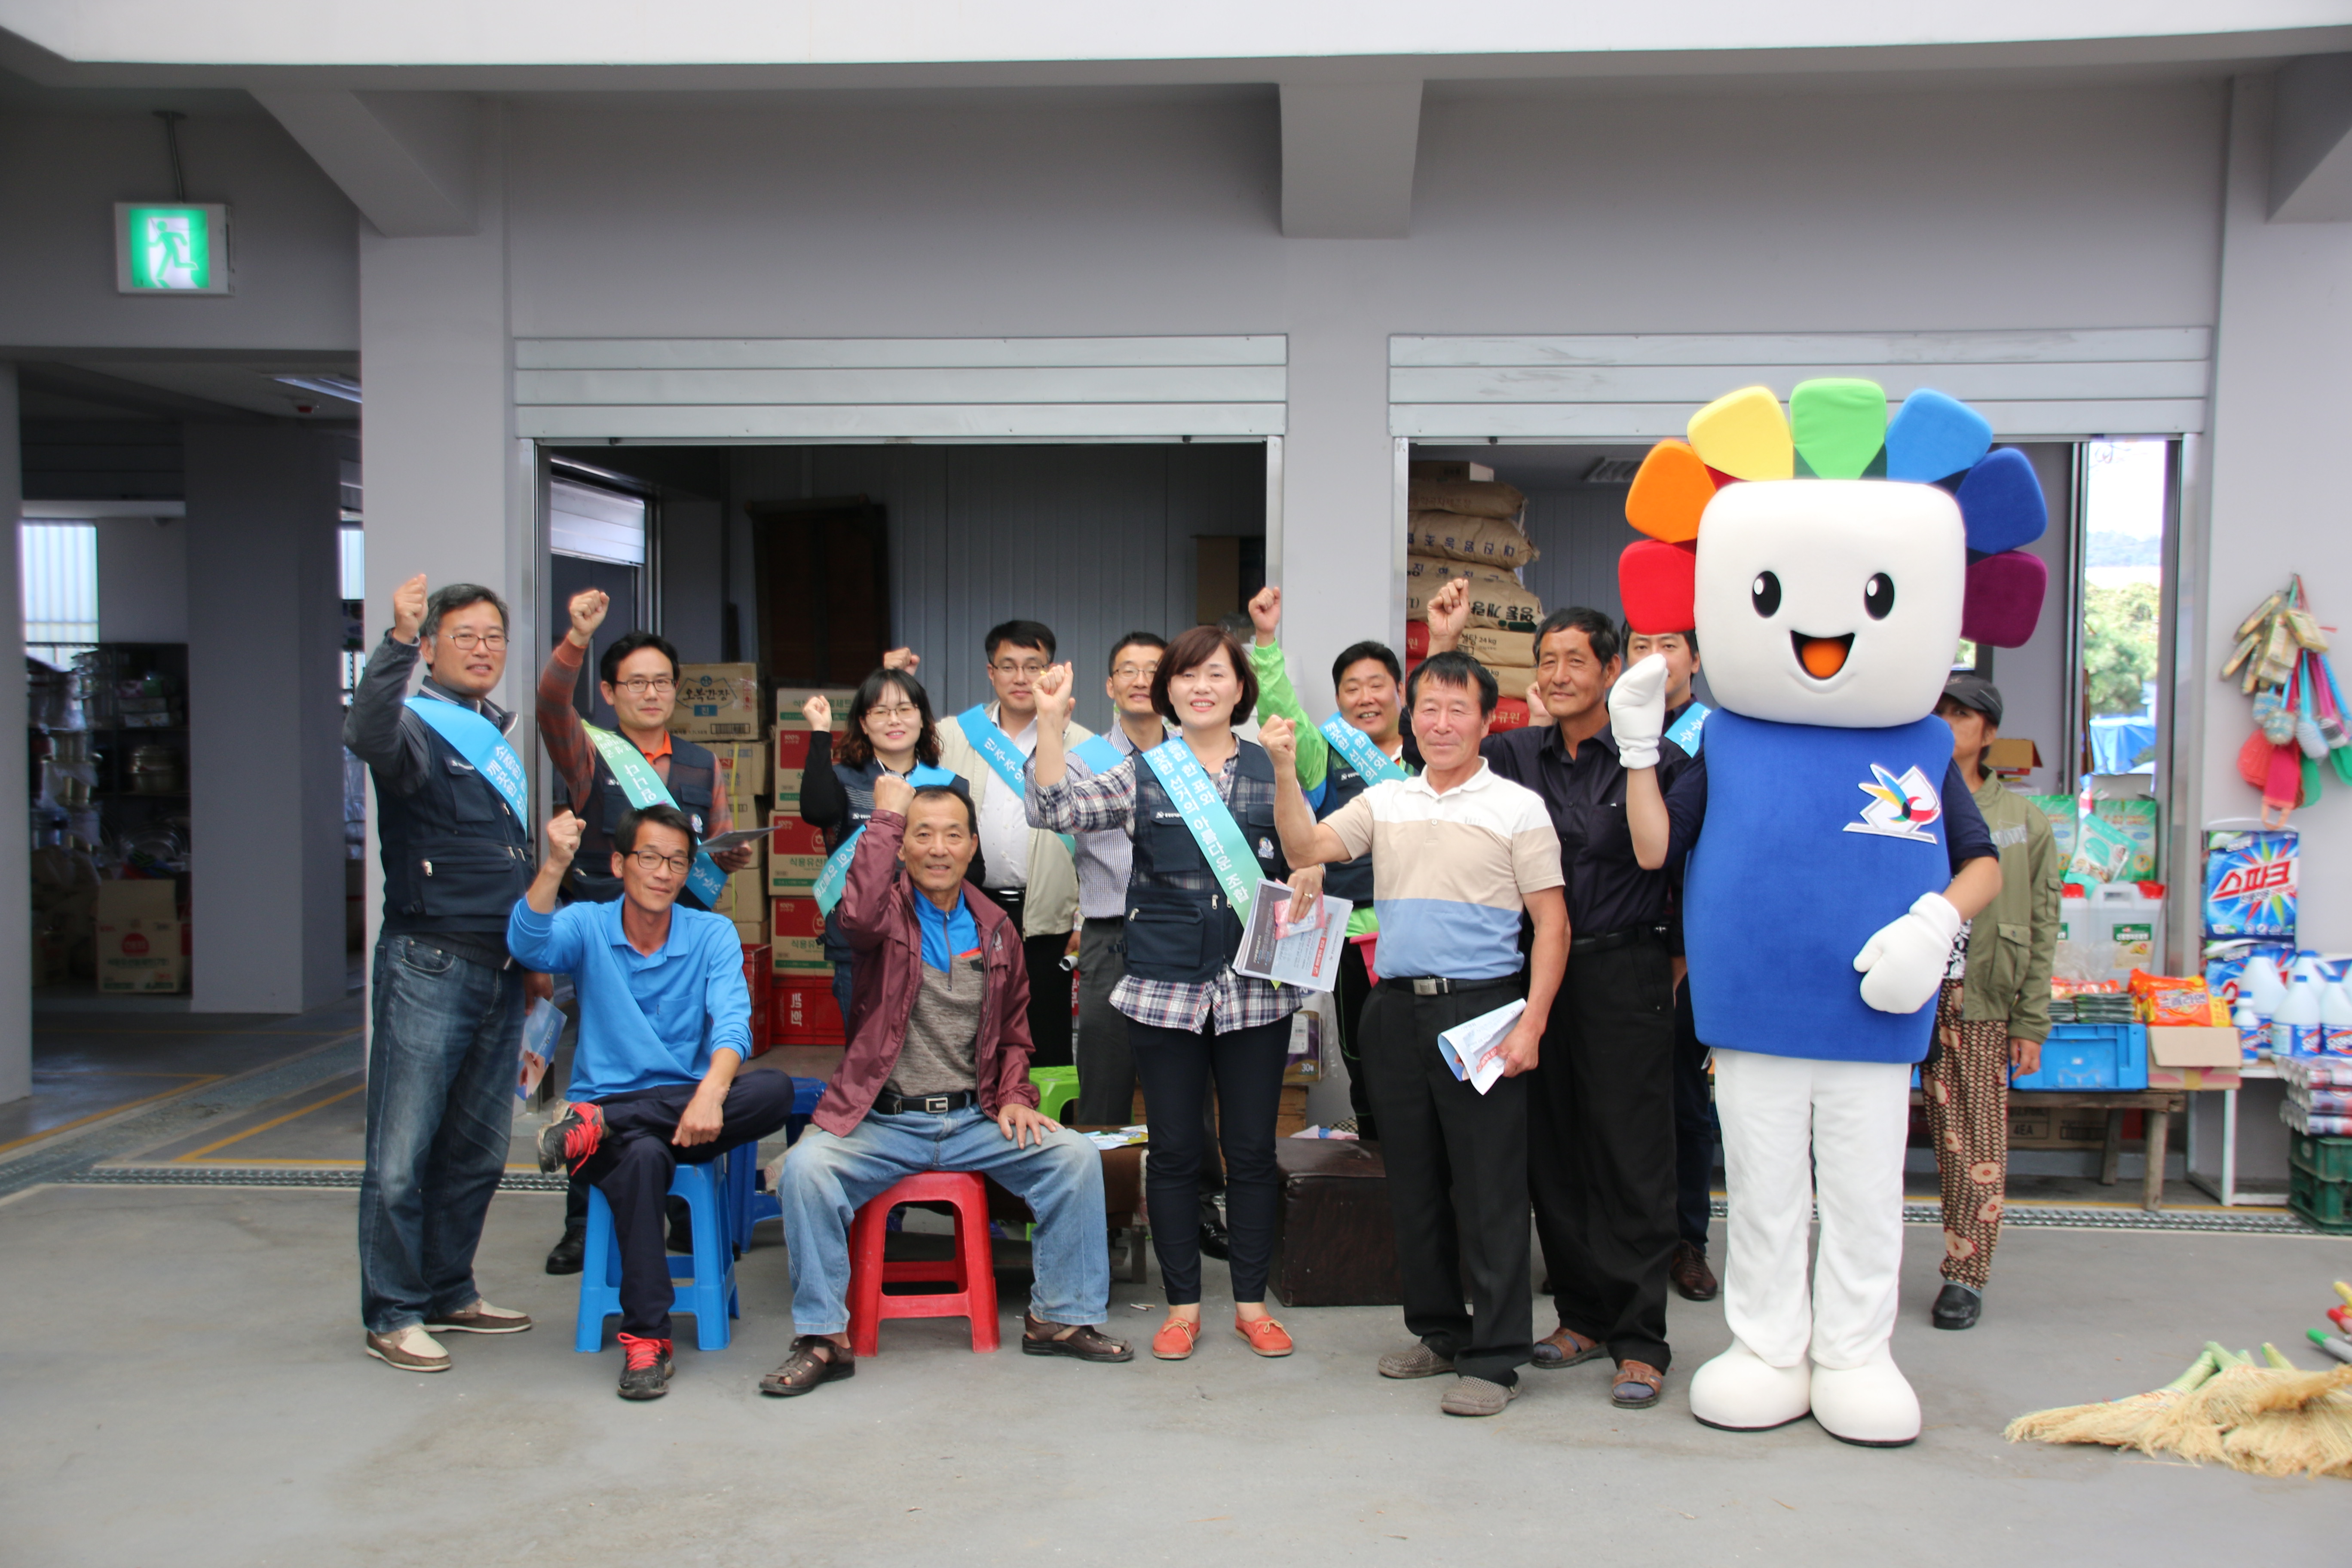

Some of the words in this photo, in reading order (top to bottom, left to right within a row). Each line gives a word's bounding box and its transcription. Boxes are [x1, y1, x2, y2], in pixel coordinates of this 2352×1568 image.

[1470, 601, 1501, 619] 개량
[1408, 638, 1418, 649] 원
[683, 688, 730, 702] 오복간장
[496, 746, 522, 780] 소중한
[984, 737, 1024, 783] 민주주의
[1324, 722, 1350, 751] 깨끗한
[1349, 748, 1378, 781] 선거의
[1365, 748, 1387, 771] 표와
[486, 759, 518, 797] 깨끗한
[624, 764, 657, 804] 입니다
[1181, 761, 1198, 778] 한
[1192, 778, 1216, 806] 표와
[1149, 747, 1175, 776] 깨끗한
[1170, 775, 1200, 815] 선거의
[1194, 815, 1232, 872] 아름다운
[1225, 873, 1250, 904] 조합
[2211, 860, 2291, 900] 스파크
